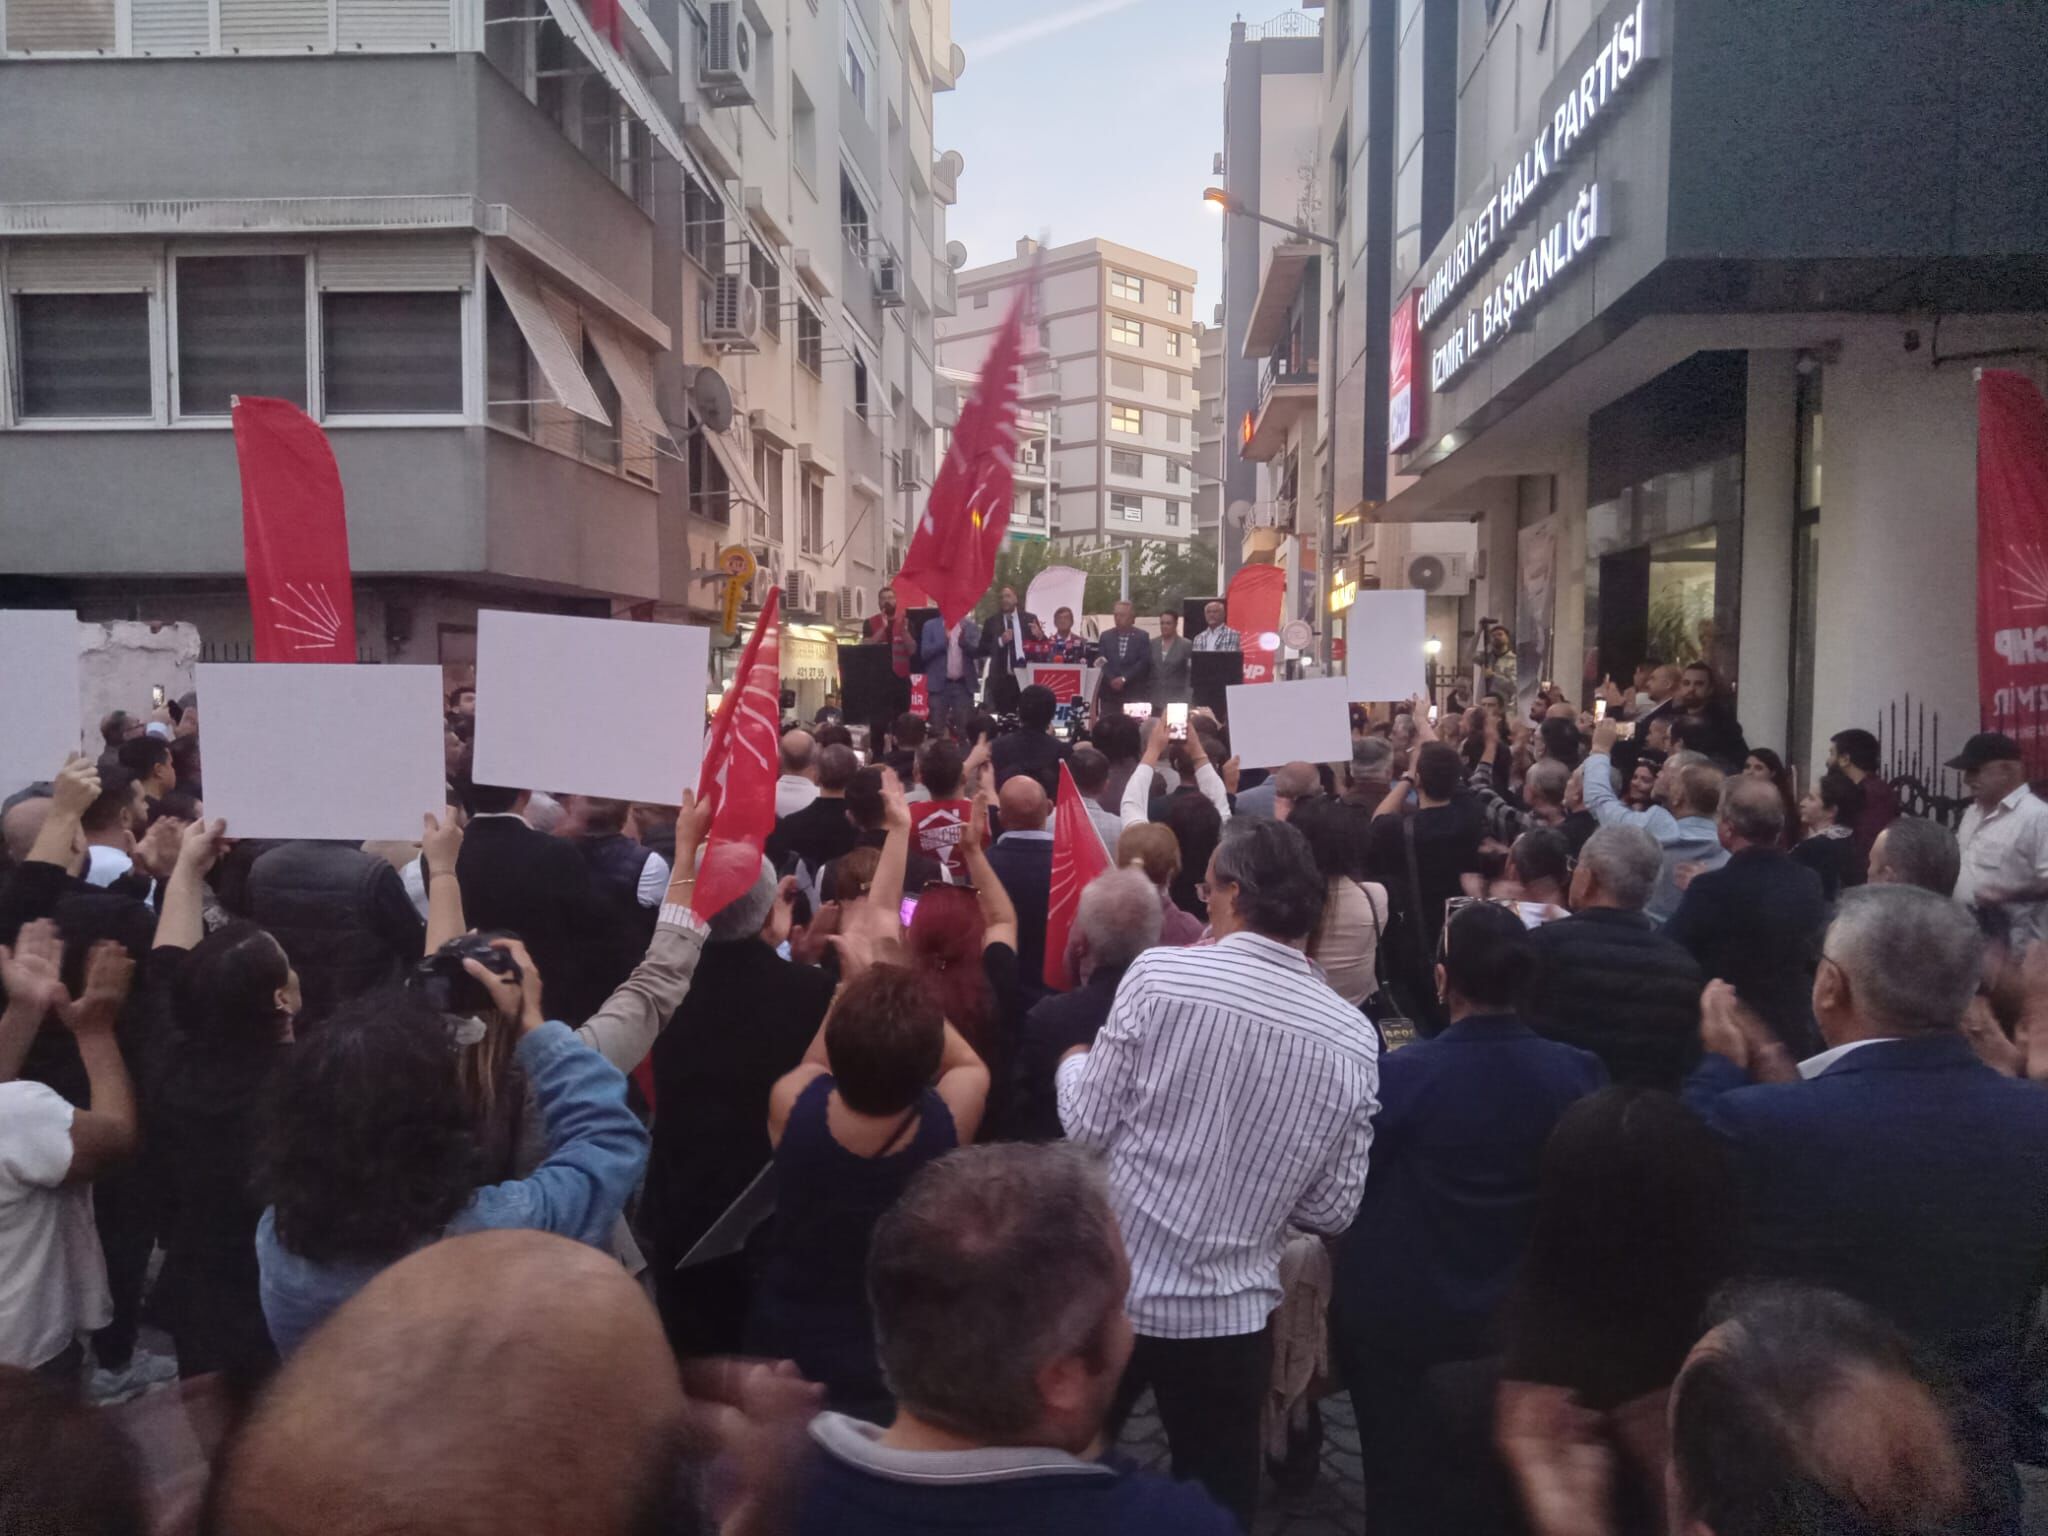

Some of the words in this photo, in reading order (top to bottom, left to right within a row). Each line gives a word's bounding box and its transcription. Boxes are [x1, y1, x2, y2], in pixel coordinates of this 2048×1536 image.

[1417, 195, 1497, 331] CUMHURİYET
[1501, 124, 1550, 230] HALK
[1432, 328, 1464, 392] İZMİR
[1467, 310, 1480, 357] İL
[1483, 183, 1598, 343] BAŞKANLIĞI
[1243, 664, 1265, 680] HP
